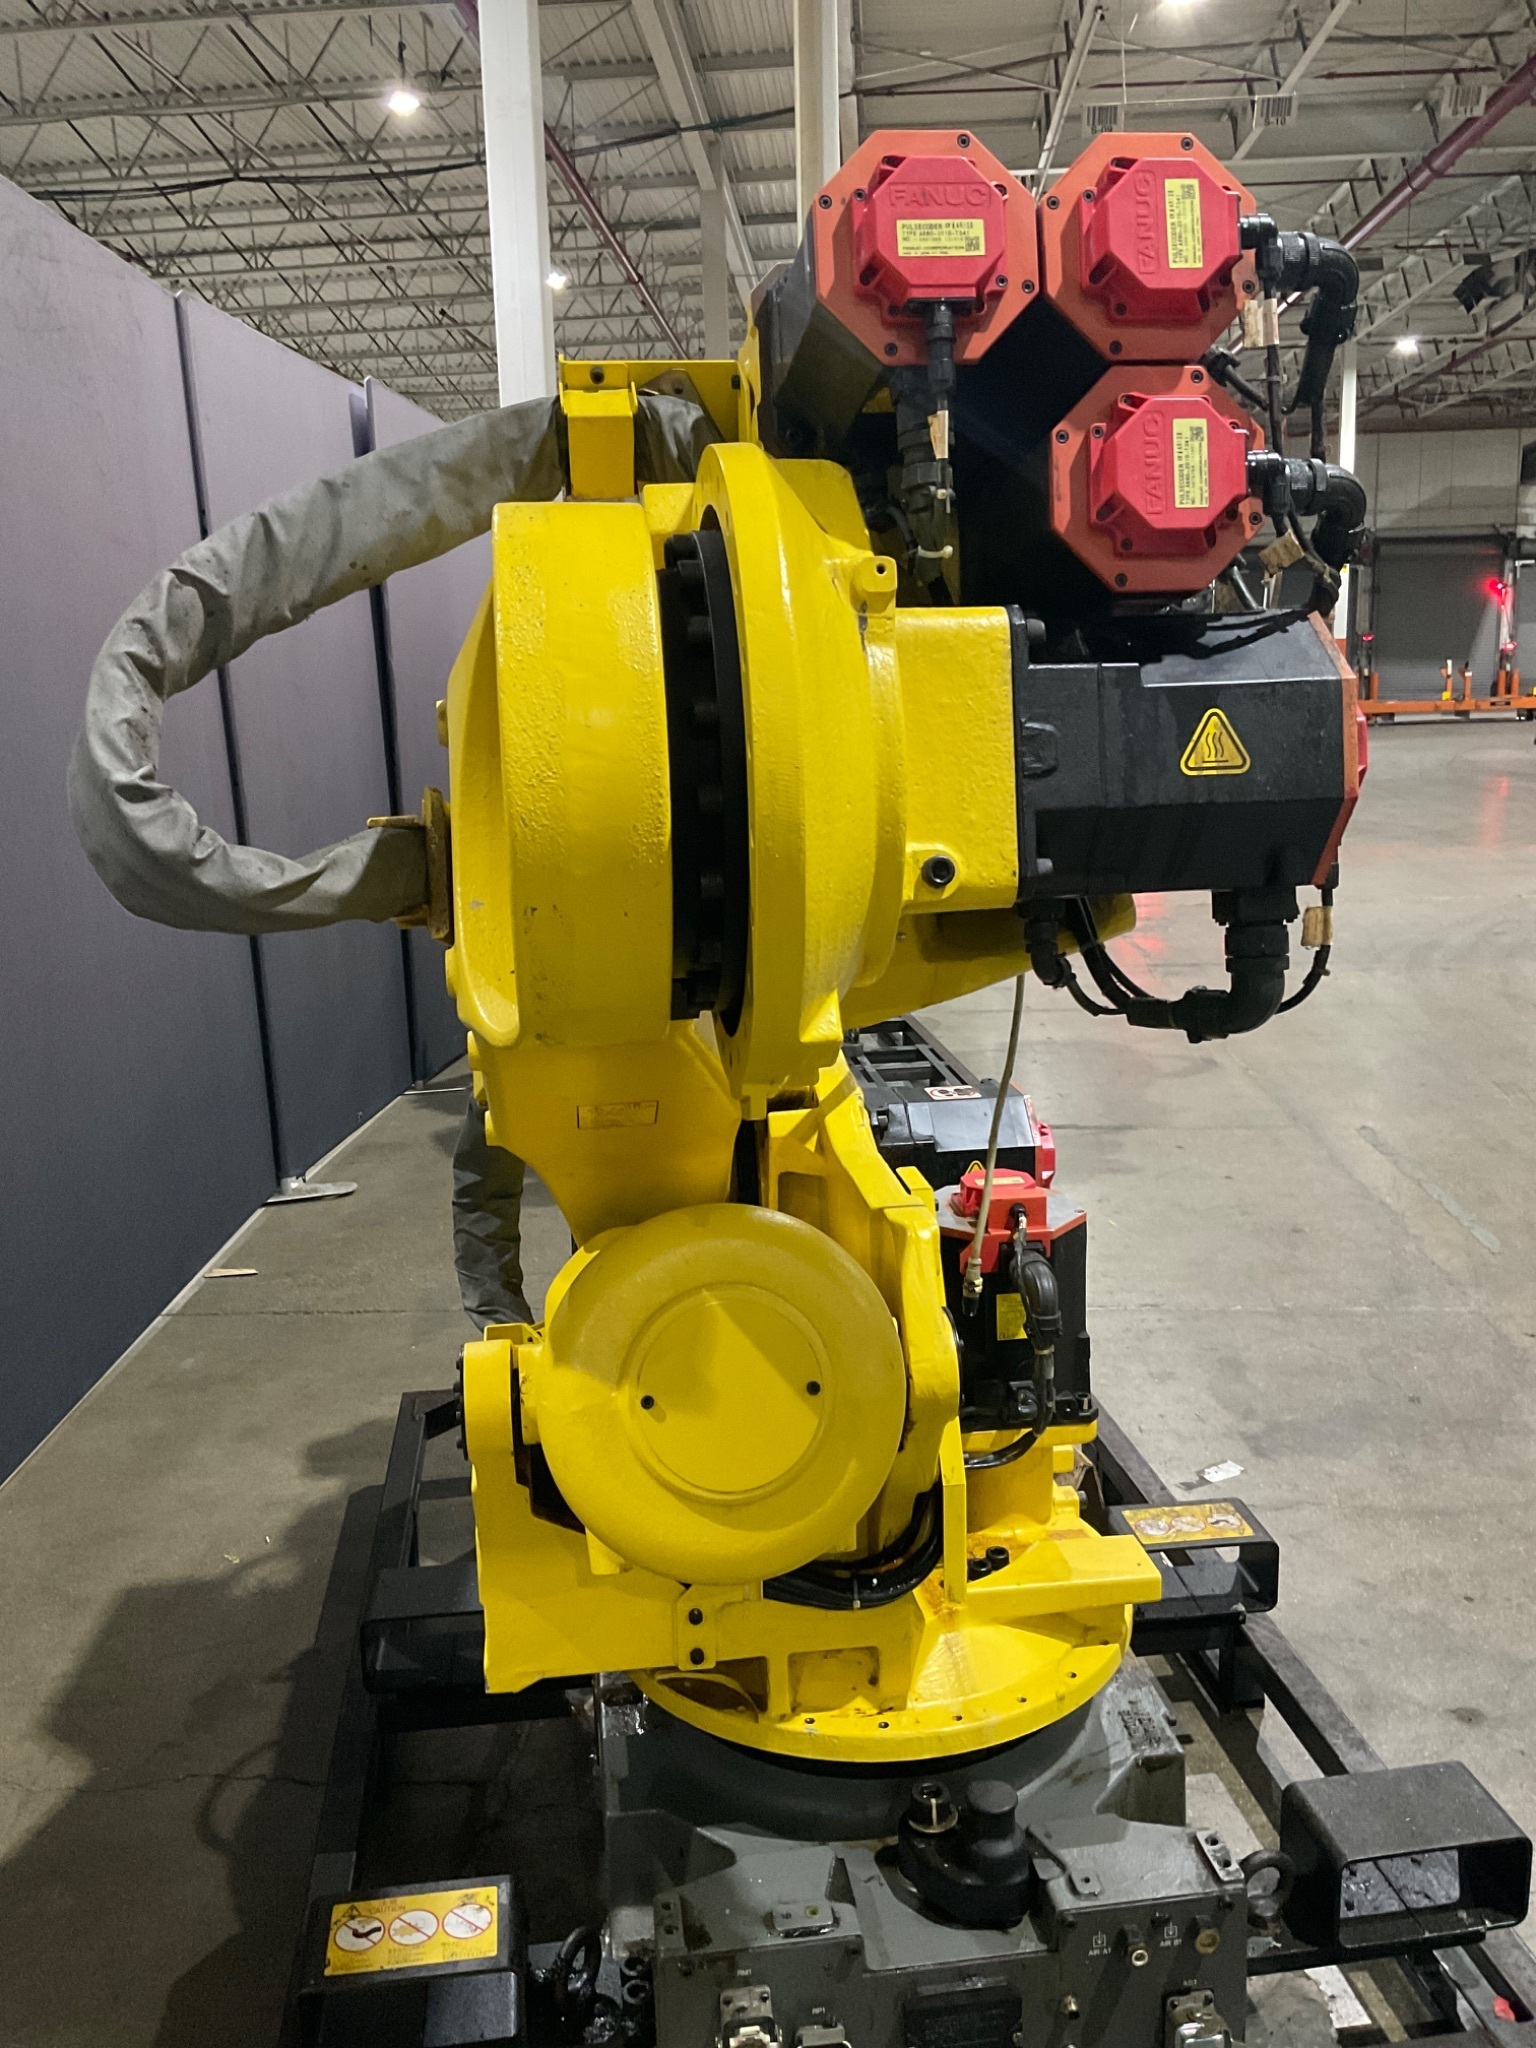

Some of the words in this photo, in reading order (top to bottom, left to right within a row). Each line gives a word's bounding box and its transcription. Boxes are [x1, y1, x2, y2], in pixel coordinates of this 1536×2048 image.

[1264, 118, 1286, 126] S-10
[890, 184, 986, 206] FANUC
[1135, 174, 1155, 275] FANUC
[1144, 414, 1162, 514] FANUC
[369, 1905, 406, 1915] CAUTION
